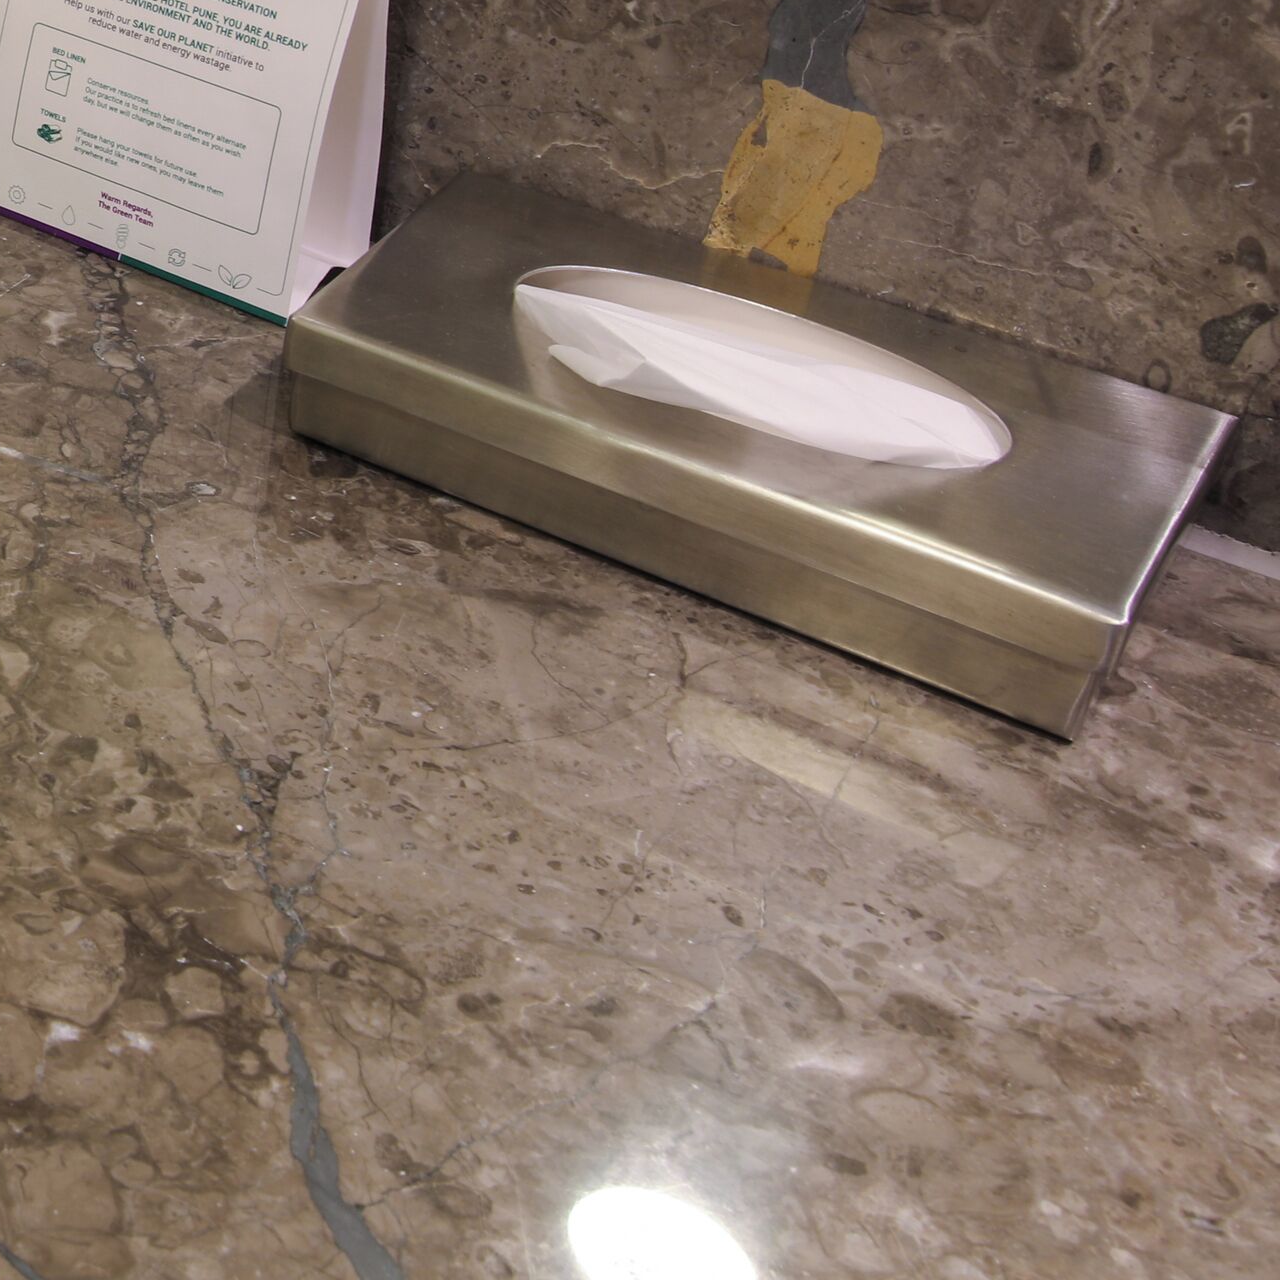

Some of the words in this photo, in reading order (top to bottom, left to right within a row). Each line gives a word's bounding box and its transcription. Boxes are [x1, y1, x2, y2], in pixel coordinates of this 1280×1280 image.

[84, 4, 95, 13] us
[96, 8, 114, 19] with
[116, 15, 131, 25] our
[131, 18, 155, 34] SAVE
[156, 27, 176, 41] OUR
[177, 34, 214, 53] PLANET
[215, 49, 253, 67] initiative
[254, 61, 264, 71] to
[88, 16, 117, 31] reduce
[118, 26, 142, 40] water
[143, 35, 161, 46] and
[161, 42, 191, 59] energy
[192, 17, 213, 30] AND
[215, 24, 233, 38] THE
[235, 31, 269, 51] WORLD.
[223, 15, 242, 29] YOU
[243, 23, 262, 36] ARE
[263, 30, 308, 51] ALREADY
[52, 46, 65, 56] BED
[66, 51, 86, 64] LINEN
[86, 76, 116, 93] Conserve
[40, 107, 66, 123] TOWELS
[84, 86, 96, 95] Our
[96, 91, 123, 105] practice
[138, 106, 161, 119] refresh
[162, 114, 175, 124] bed
[176, 119, 195, 132] linens
[196, 128, 215, 140] every
[215, 135, 246, 150] alternate
[96, 99, 107, 109] but
[108, 105, 118, 113] we
[119, 109, 130, 117] will
[130, 113, 154, 126] change
[155, 121, 172, 132] them
[182, 132, 200, 143] often
[200, 139, 209, 147] as
[210, 143, 223, 151] you
[73, 146, 103, 161] anywhere
[76, 126, 97, 140] Please
[98, 135, 115, 148] hang
[115, 143, 130, 151] your
[131, 147, 152, 160] towels
[153, 155, 163, 164] for
[163, 159, 183, 172] future
[80, 139, 92, 147] you
[93, 144, 113, 155] would
[114, 150, 125, 159] like
[126, 156, 139, 164] new
[158, 168, 171, 177] you
[171, 173, 186, 184] may
[187, 177, 205, 189] leave
[206, 185, 224, 196] them
[98, 199, 110, 210] The
[111, 205, 133, 219] Green
[134, 213, 153, 227] Team
[100, 191, 121, 204] Warm
[122, 199, 153, 218] Regards,
